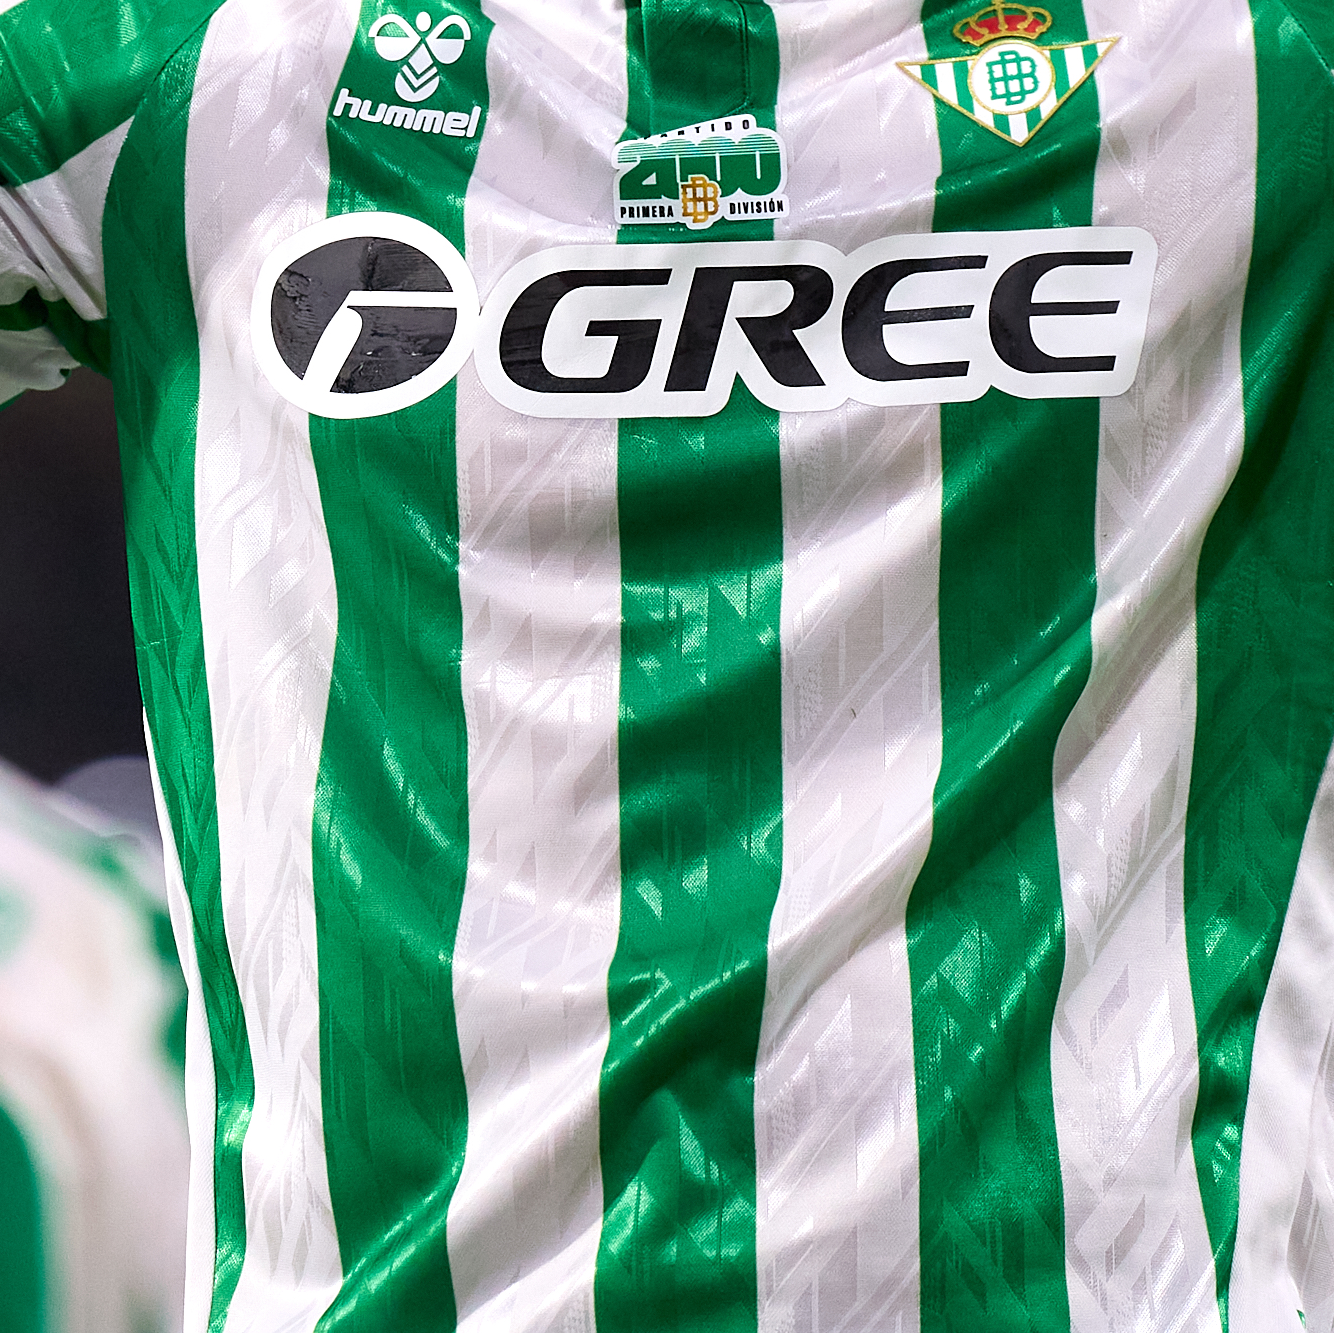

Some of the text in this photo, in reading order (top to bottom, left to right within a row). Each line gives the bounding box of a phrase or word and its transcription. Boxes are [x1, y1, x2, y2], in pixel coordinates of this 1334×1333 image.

[332, 87, 482, 138] hummel
[620, 198, 784, 219] PRIMERA DIVISIÓN
[498, 250, 1134, 394] GREE
